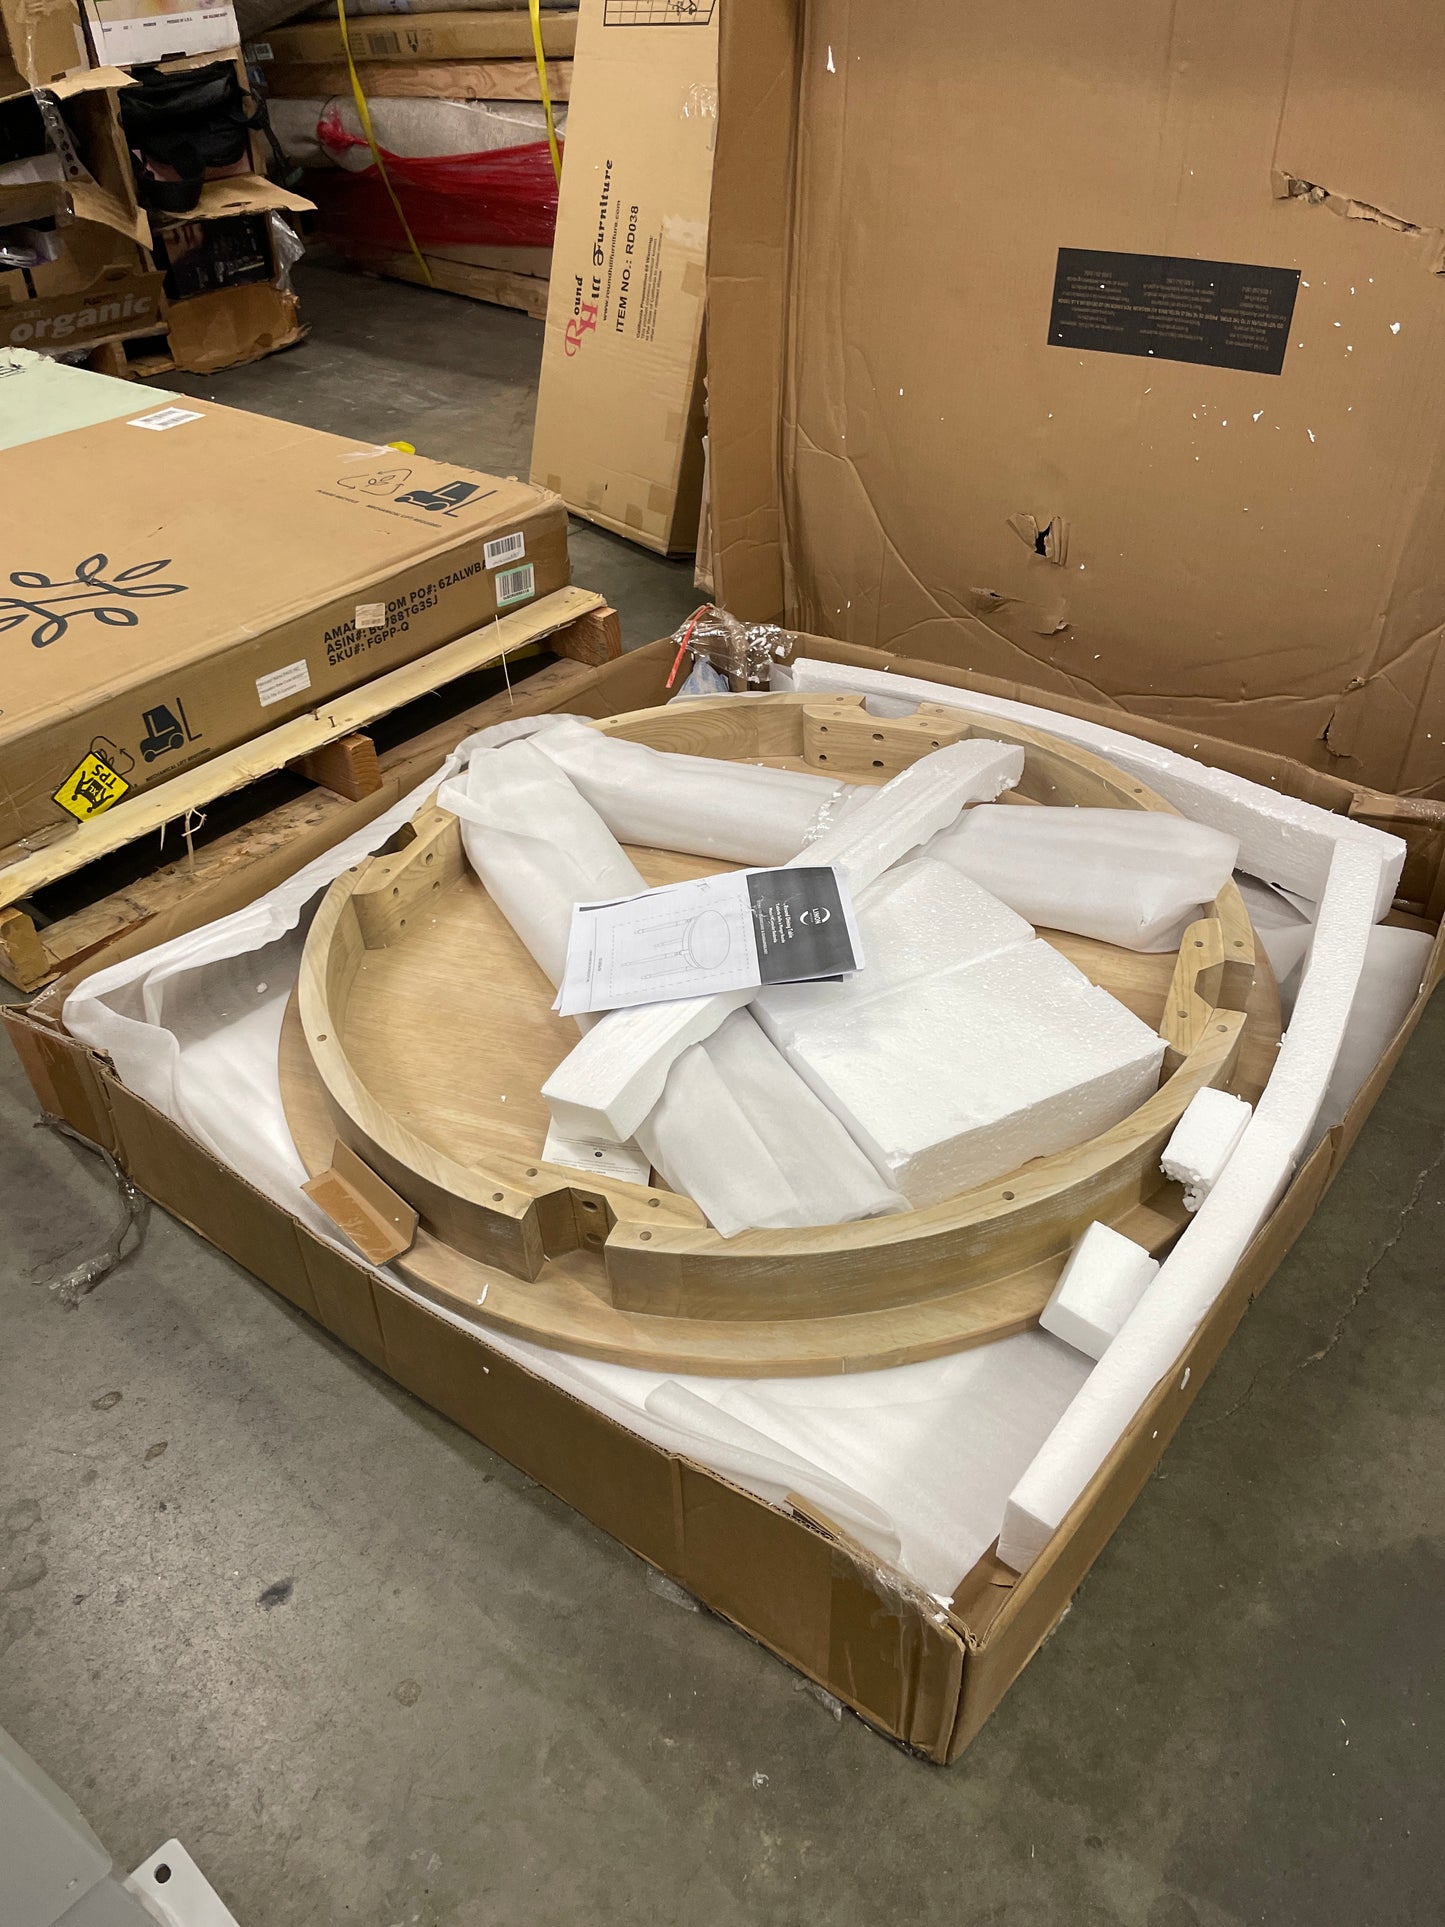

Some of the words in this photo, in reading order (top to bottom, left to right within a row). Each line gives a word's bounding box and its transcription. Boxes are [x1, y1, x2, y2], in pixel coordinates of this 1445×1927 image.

[593, 160, 613, 267] Furniture
[625, 205, 639, 255] RD038
[603, 200, 621, 321] www.roundhillfurniture.com
[622, 259, 632, 292] NO.:
[10, 293, 151, 342] organic
[616, 296, 628, 333] ITEM
[324, 596, 406, 643] AMAZOM
[410, 584, 437, 603] PO#:
[326, 628, 367, 655] ASIN#:
[328, 643, 365, 666] SKU#:
[367, 621, 410, 648] FGPP-Q
[91, 764, 118, 790] TPS
